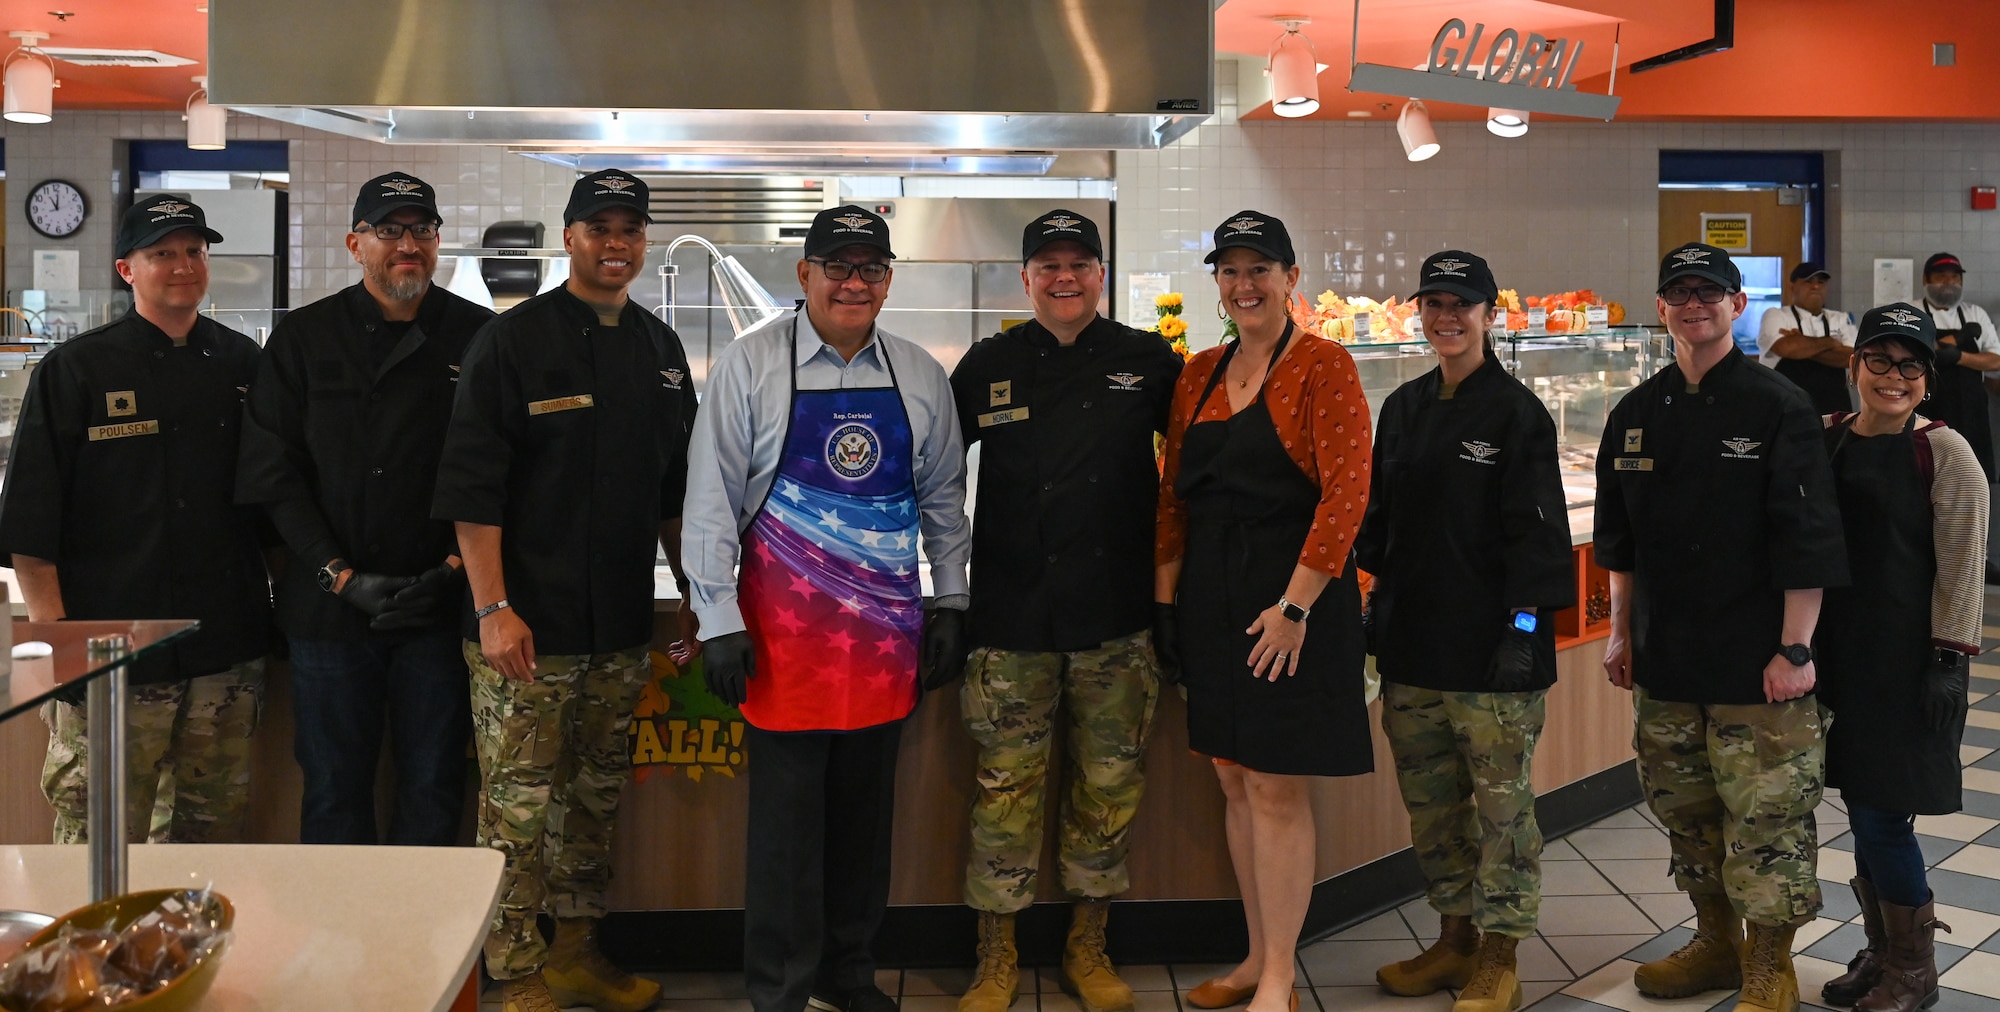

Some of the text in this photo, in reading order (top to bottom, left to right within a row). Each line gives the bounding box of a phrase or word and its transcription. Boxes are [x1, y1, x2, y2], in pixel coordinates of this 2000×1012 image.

[1427, 17, 1585, 92] GLOBAL
[43, 186, 49, 195] 11
[52, 184, 60, 192] 12
[34, 194, 43, 203] 10
[72, 193, 78, 202] 2
[32, 205, 39, 214] 9
[76, 204, 82, 213] 3
[37, 216, 43, 224] 8
[73, 215, 79, 223] 4
[45, 223, 50, 231] 7
[66, 222, 72, 231] 5
[1708, 221, 1745, 229] CAUTION
[55, 226, 62, 234] 6
[541, 397, 582, 412] SUMMERS
[832, 412, 873, 420] Rep. Carbajal
[992, 411, 1015, 424] HORNE
[99, 423, 149, 438] POULSEN
[841, 426, 867, 435] HOUSE
[866, 433, 875, 443] OF
[1458, 453, 1471, 461] FOOD
[829, 452, 878, 477] REPRESENTATIVES
[628, 718, 745, 765] ALL!
